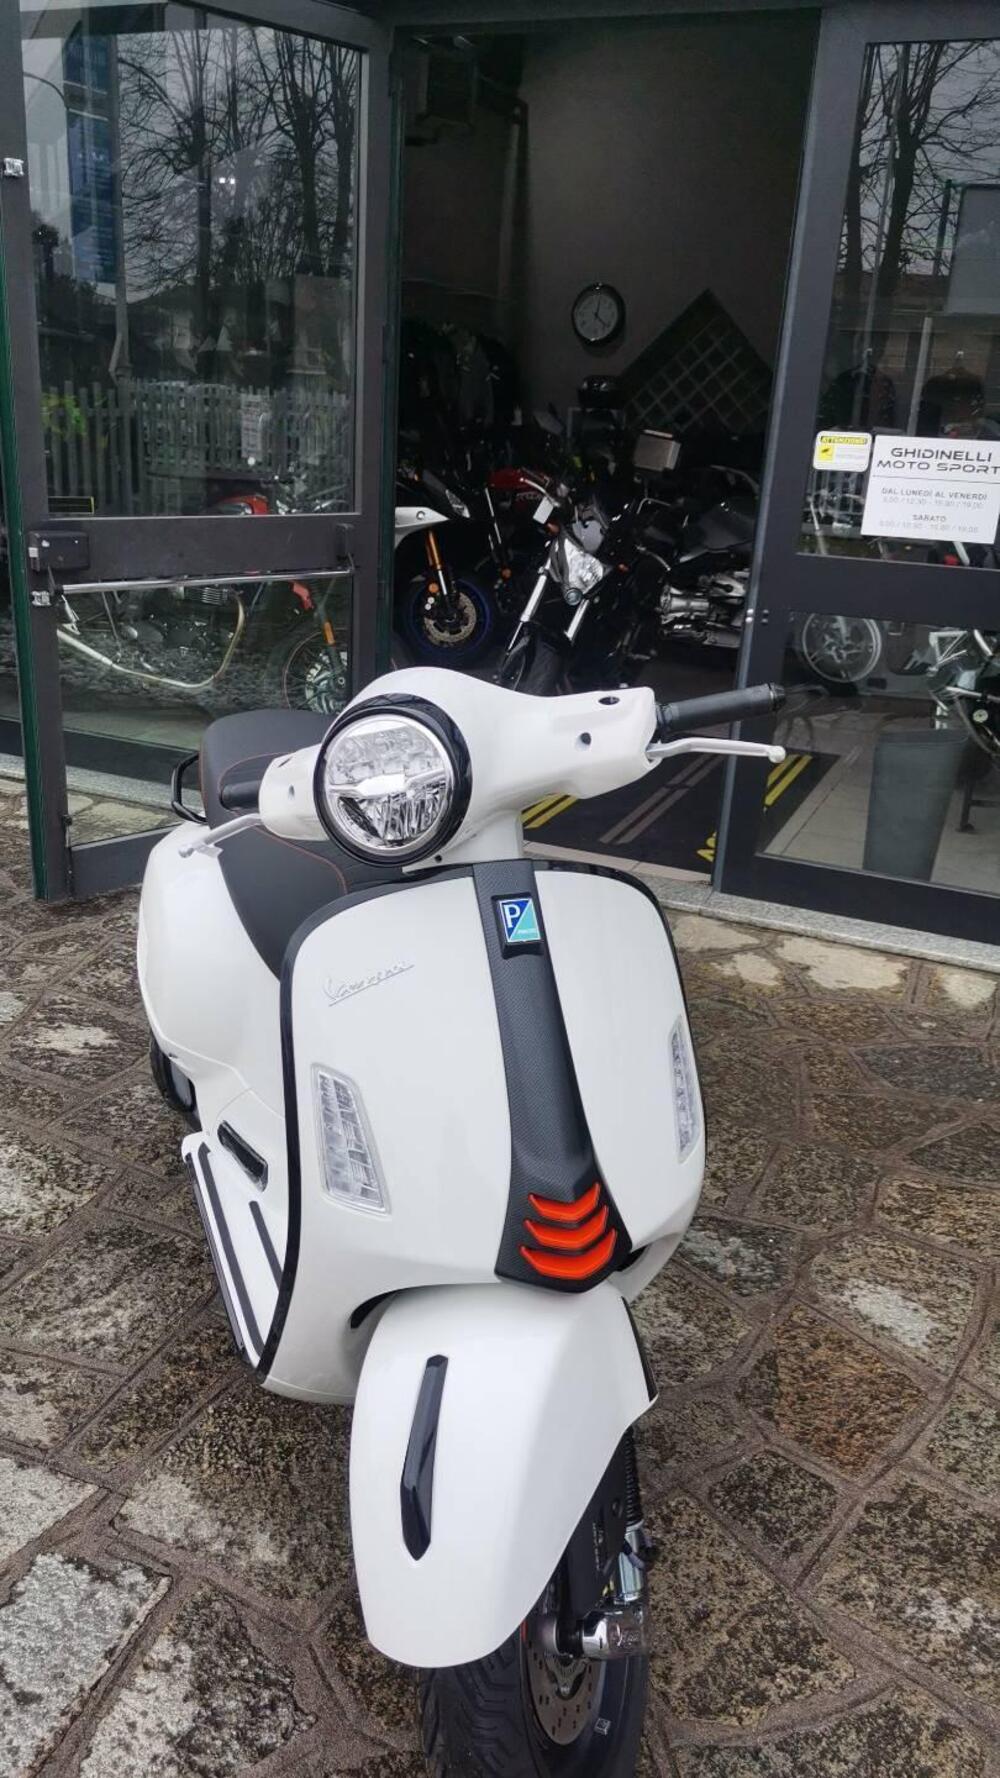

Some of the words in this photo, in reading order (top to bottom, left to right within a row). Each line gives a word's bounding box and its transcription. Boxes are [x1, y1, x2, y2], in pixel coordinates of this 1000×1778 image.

[891, 447, 992, 462] GHIDINELLI
[877, 460, 930, 470] MOTO
[936, 463, 1000, 475] SPORT
[503, 904, 521, 928] P
